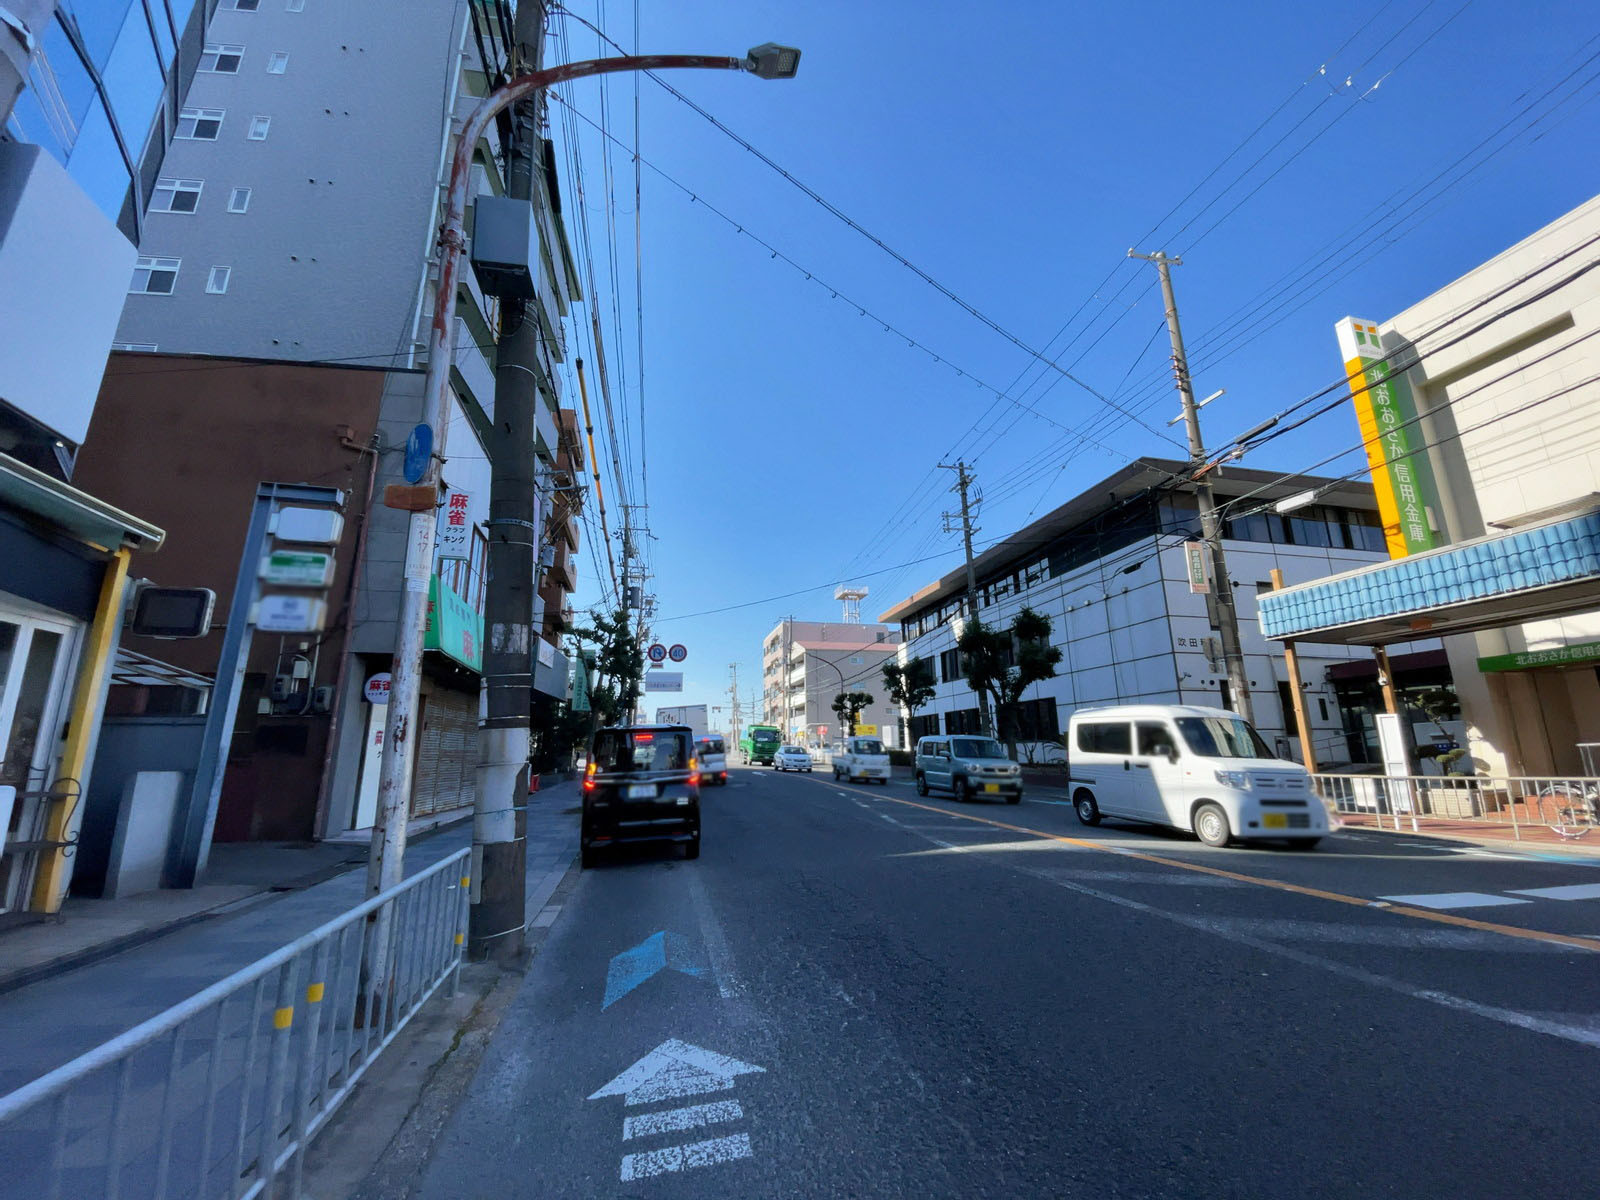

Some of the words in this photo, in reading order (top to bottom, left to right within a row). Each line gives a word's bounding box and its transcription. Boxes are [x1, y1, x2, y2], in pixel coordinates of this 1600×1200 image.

[449, 494, 469, 526] 麻雀
[443, 536, 465, 544] キング
[1178, 638, 1204, 647] 吹田
[672, 649, 684, 658] 40
